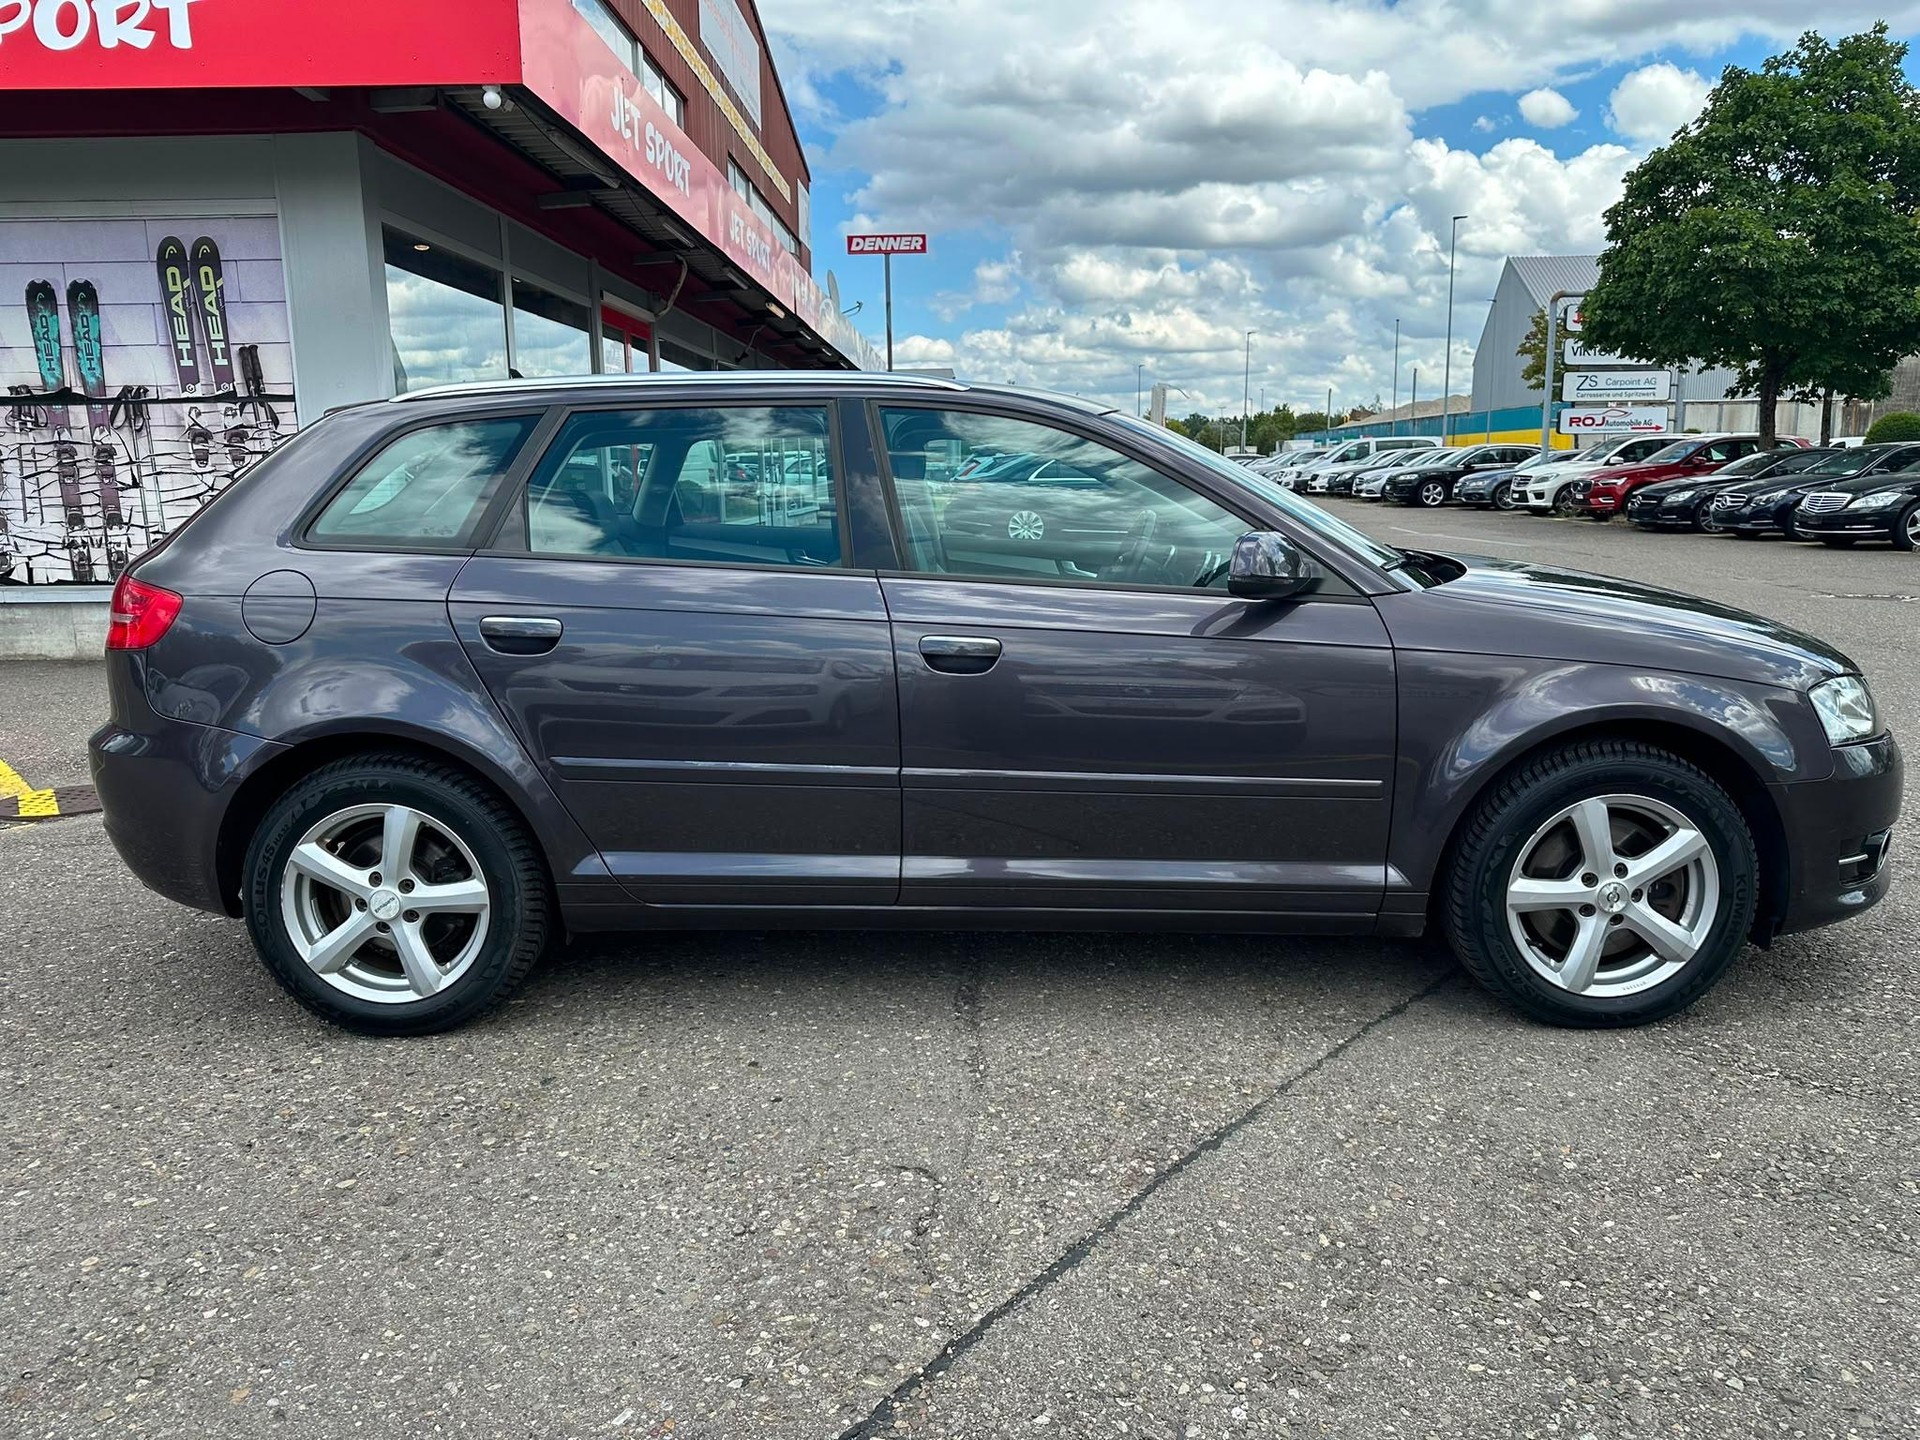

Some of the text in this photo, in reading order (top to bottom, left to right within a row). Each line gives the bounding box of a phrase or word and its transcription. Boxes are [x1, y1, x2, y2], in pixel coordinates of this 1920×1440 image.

[611, 86, 641, 151] JET
[645, 121, 691, 198] SPORT
[729, 210, 771, 273] JET SPORT
[850, 236, 923, 251] DENNER
[40, 314, 56, 372] HEAD
[80, 314, 96, 371] HEAD
[166, 266, 194, 367] HEAD
[199, 265, 229, 366] HEAD
[1576, 375, 1657, 391] ZS Carpoint AG
[1569, 416, 1605, 427] ROJ
[1605, 419, 1642, 427] Automobile
